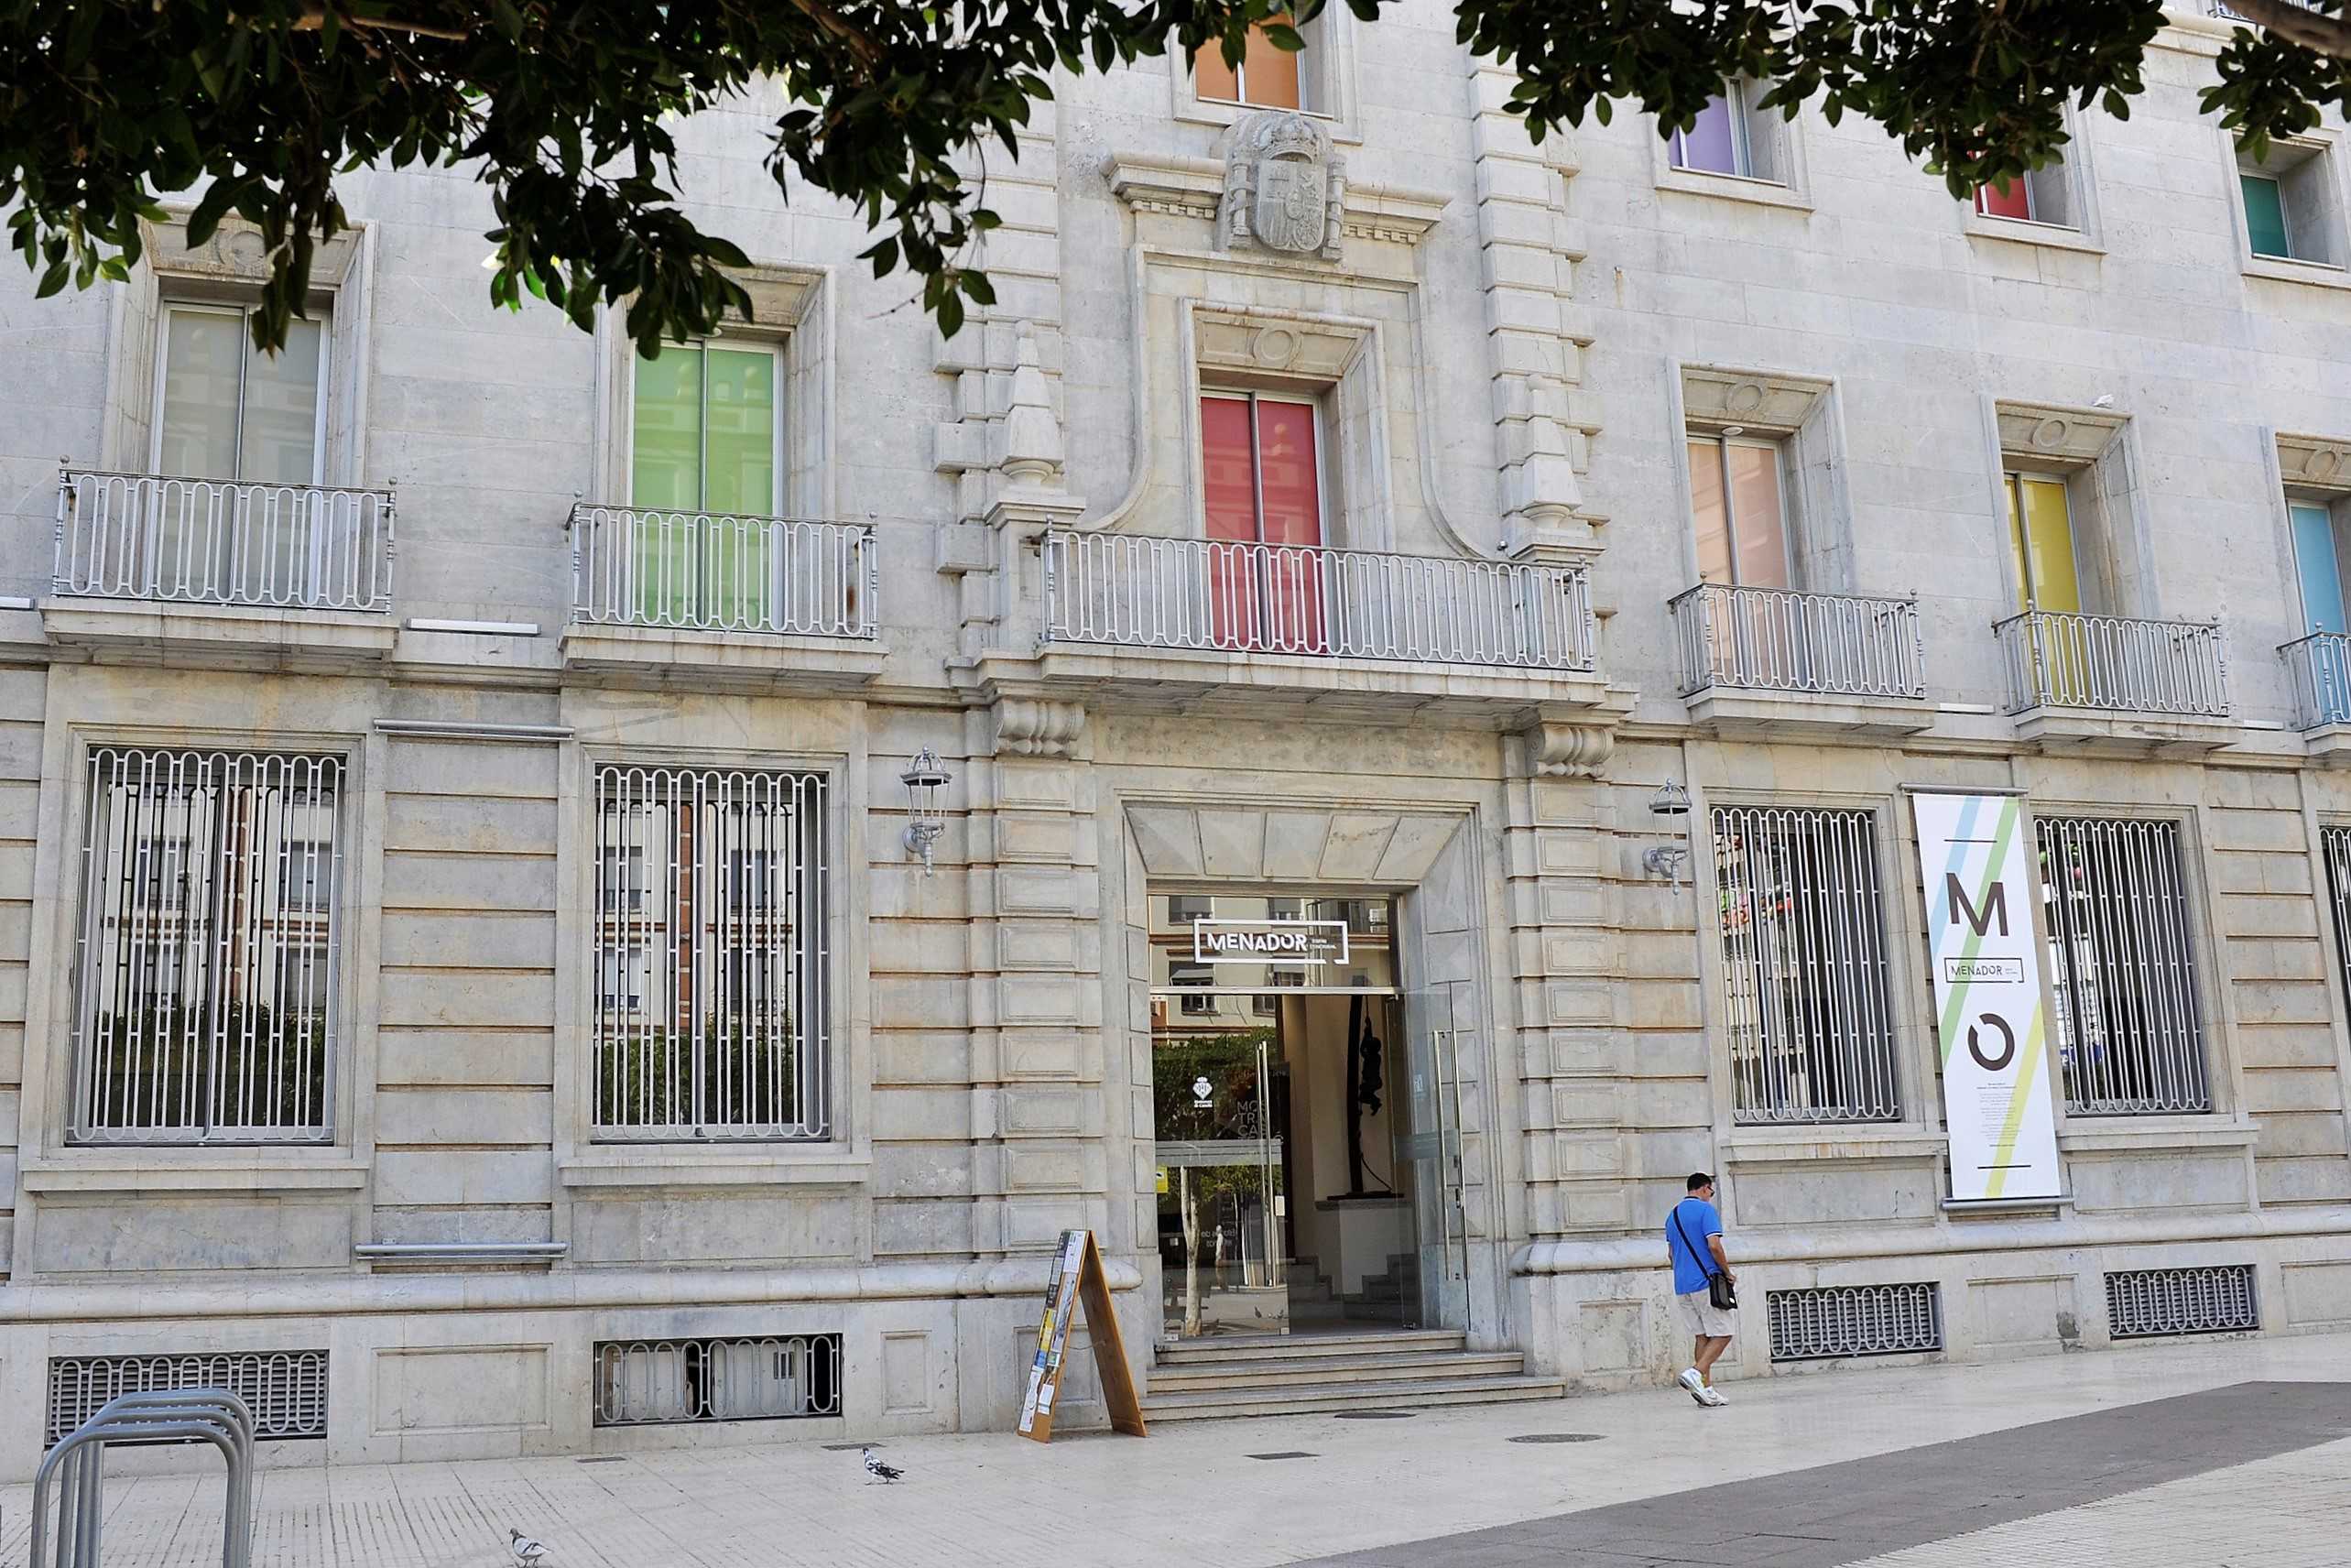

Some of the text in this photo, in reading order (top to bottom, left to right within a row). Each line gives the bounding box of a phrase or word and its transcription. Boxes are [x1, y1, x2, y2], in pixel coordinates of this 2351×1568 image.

[1946, 873, 2008, 936] M
[1207, 932, 1307, 952] MENADOR
[1950, 965, 2002, 975] MENADOR
[1967, 1013, 2015, 1072] O
